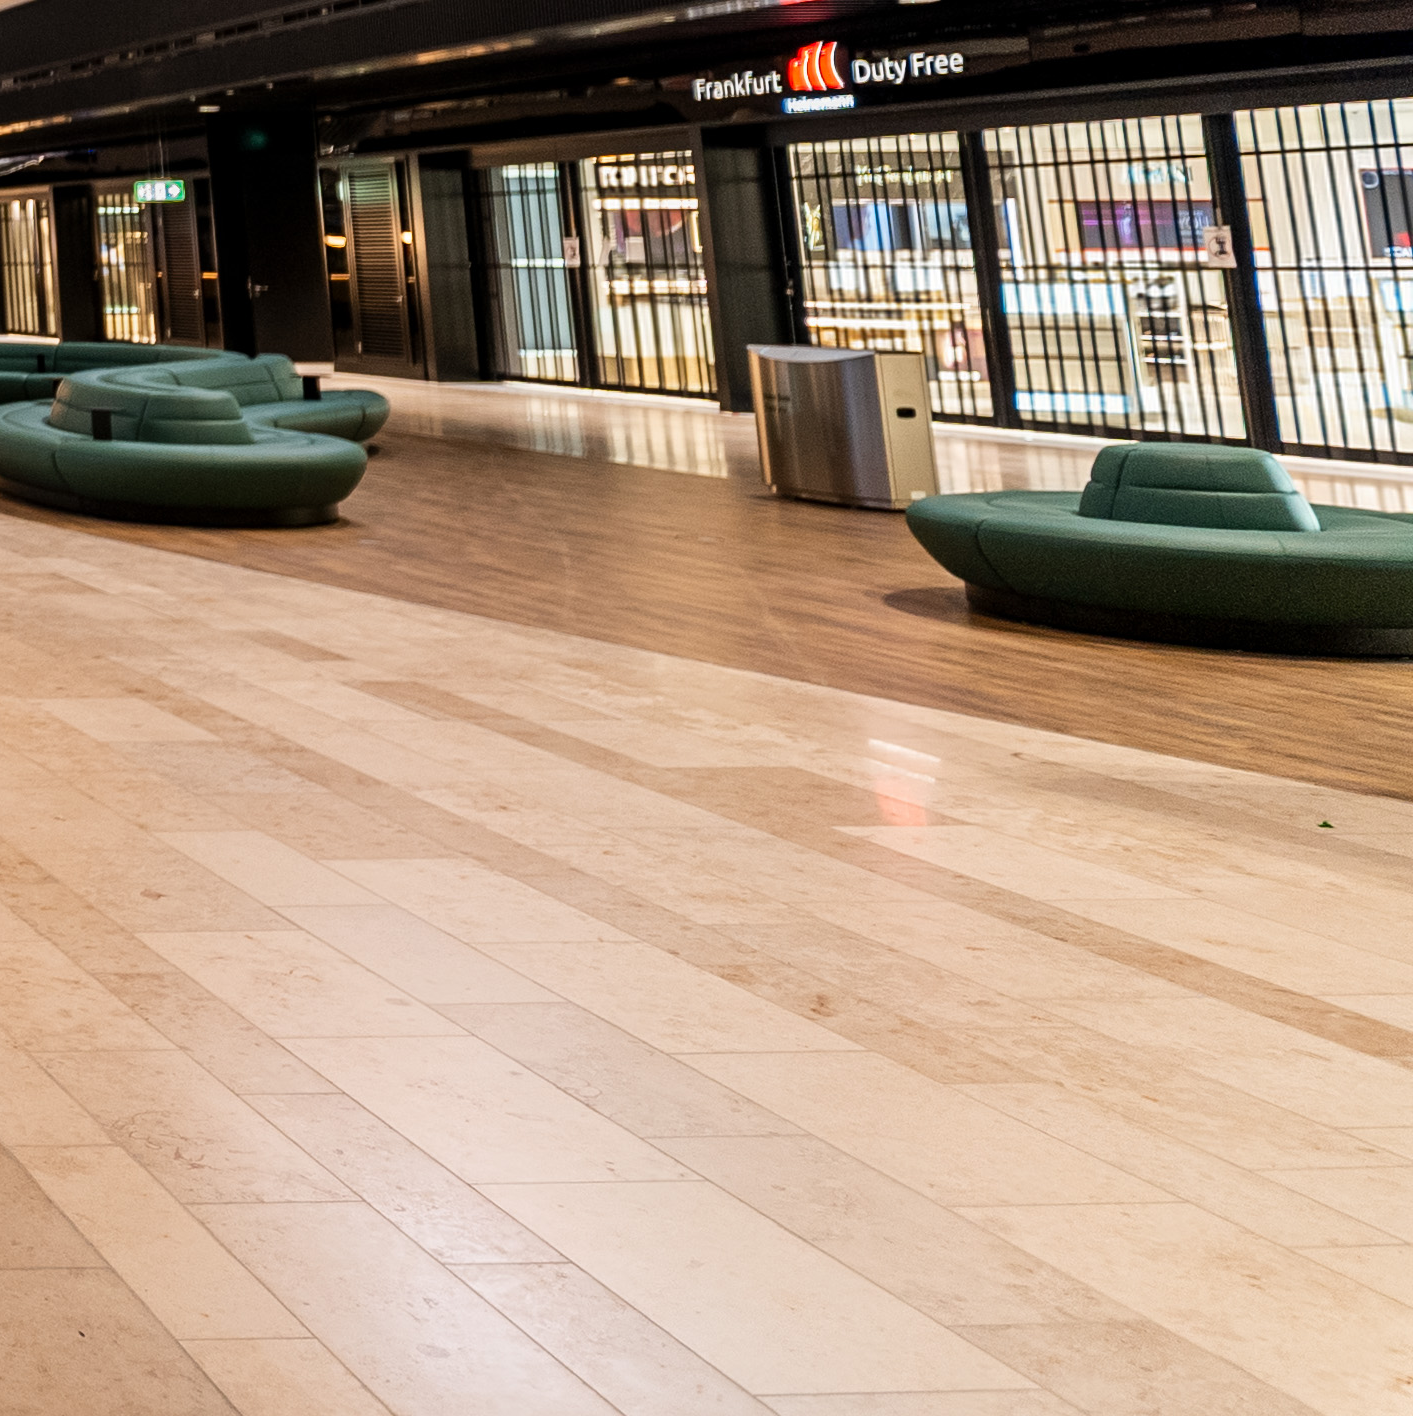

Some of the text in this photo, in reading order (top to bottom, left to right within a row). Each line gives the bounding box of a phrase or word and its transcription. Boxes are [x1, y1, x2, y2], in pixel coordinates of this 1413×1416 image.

[692, 51, 965, 102] Frankfurt Duty Free
